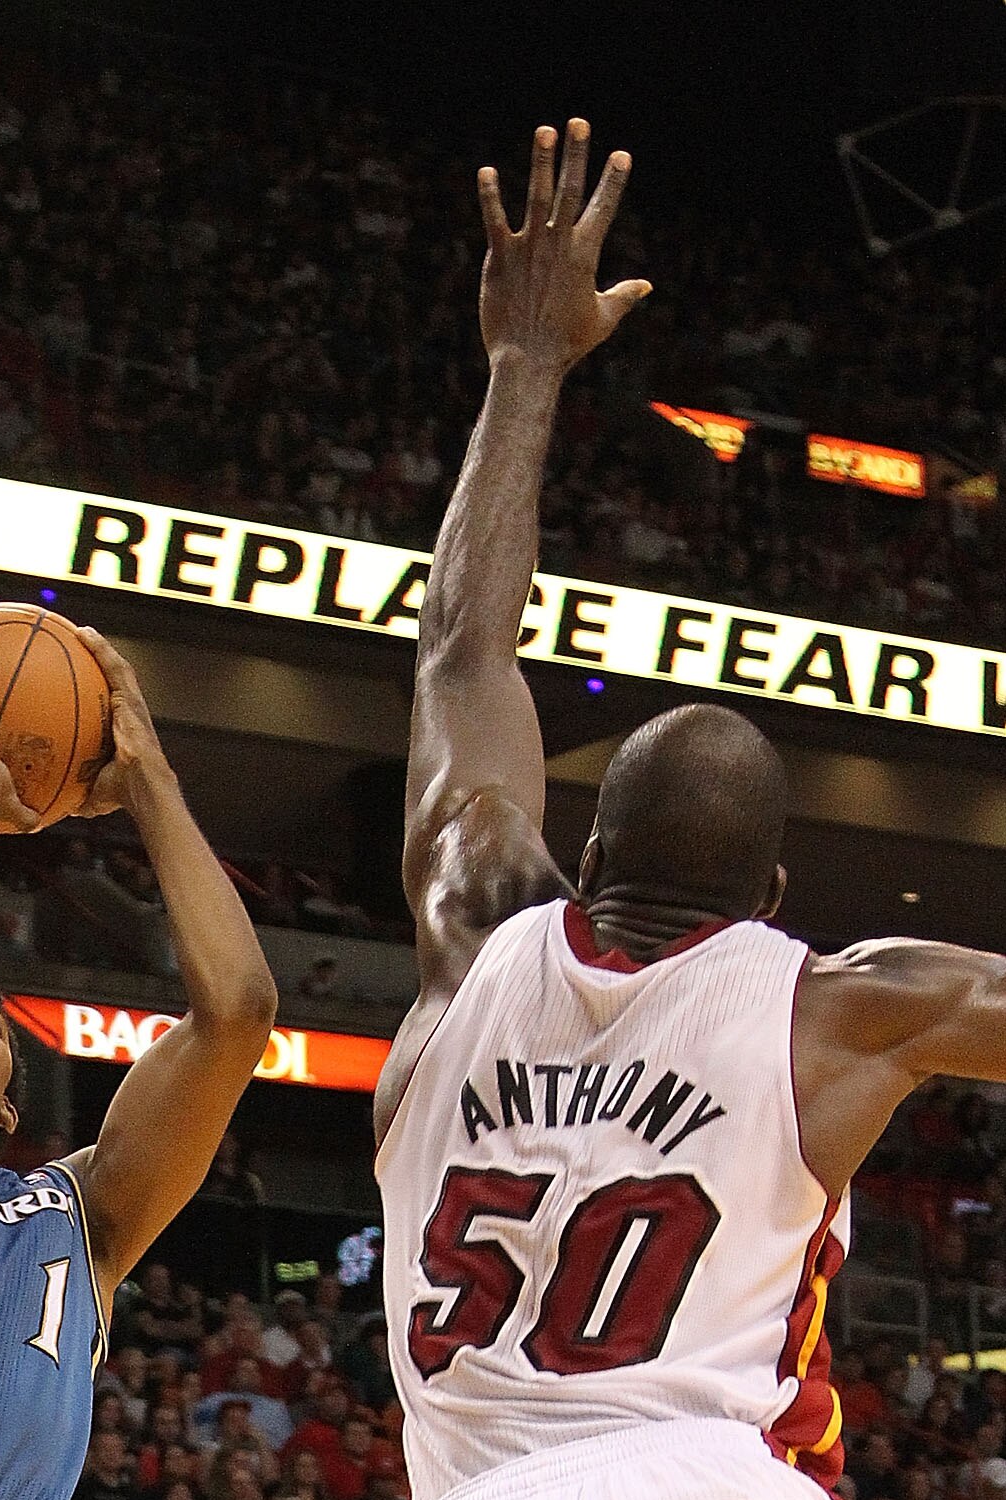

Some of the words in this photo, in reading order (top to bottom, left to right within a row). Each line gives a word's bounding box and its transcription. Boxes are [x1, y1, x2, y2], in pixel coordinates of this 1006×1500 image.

[657, 607, 934, 716] FEAR
[63, 1003, 314, 1083] BACDI
[461, 1059, 727, 1156] ANTHONY
[25, 1256, 71, 1368] 1
[407, 1165, 722, 1381] 50
